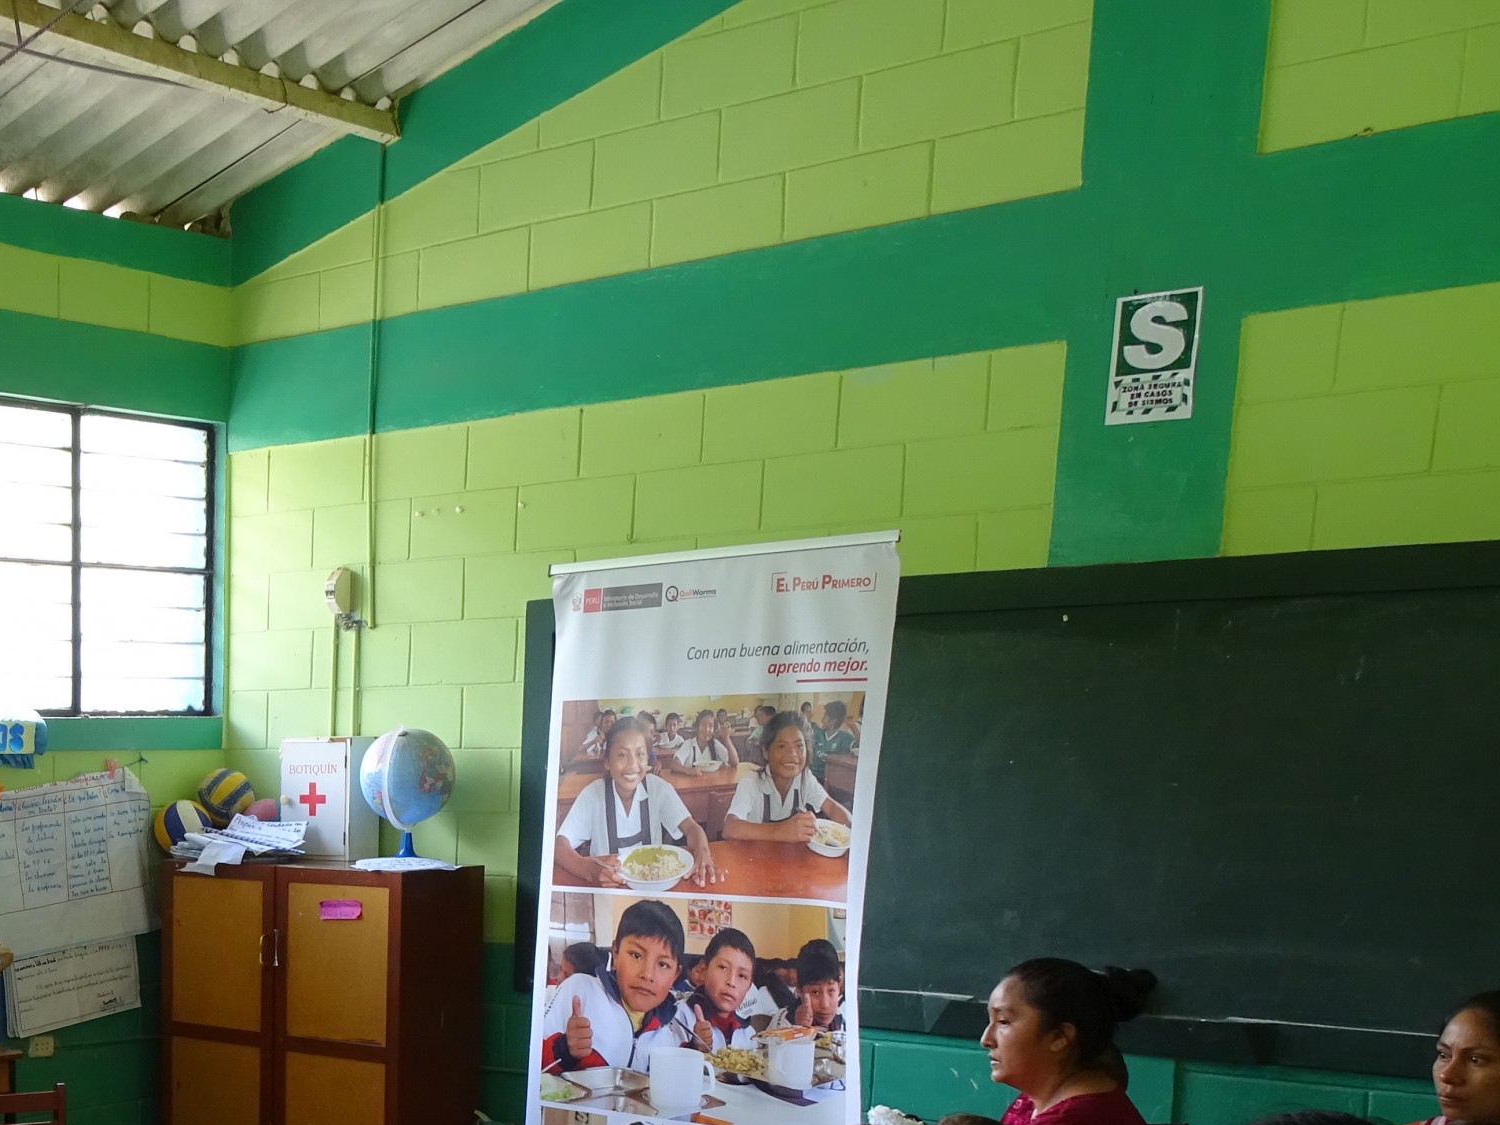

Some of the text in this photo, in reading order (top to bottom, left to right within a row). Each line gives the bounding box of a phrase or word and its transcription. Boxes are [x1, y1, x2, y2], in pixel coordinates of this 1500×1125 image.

[1123, 300, 1188, 369] S
[1122, 380, 1182, 394] ZONA SEGURA
[1130, 389, 1173, 400] EN CASOS
[1127, 397, 1173, 408] DE SISMOS
[687, 637, 870, 660] Con una buena alimentación,
[767, 657, 868, 677] aprendo mejor.
[289, 762, 337, 775] BOTIQUÍN
